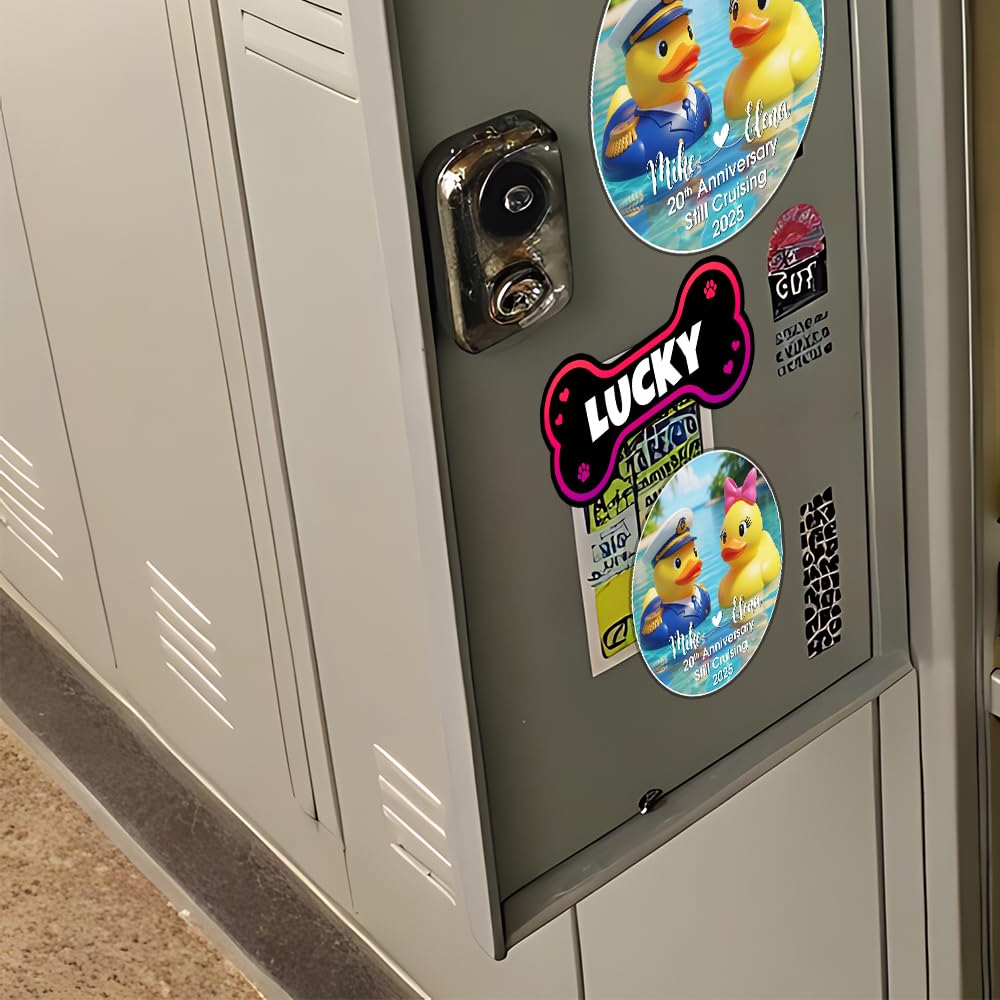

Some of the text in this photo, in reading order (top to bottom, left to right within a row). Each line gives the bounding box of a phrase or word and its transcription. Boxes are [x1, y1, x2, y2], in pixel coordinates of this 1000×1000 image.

[646, 99, 792, 196] Mike Elena
[666, 138, 779, 217] 20th Anniversary
[684, 168, 768, 231] Still Cruising
[712, 203, 746, 239] 2025
[584, 320, 703, 444] LUCKY
[683, 619, 755, 673] 20th Anniversary
[694, 639, 750, 682] Still Cruising
[712, 663, 735, 687] 2025
